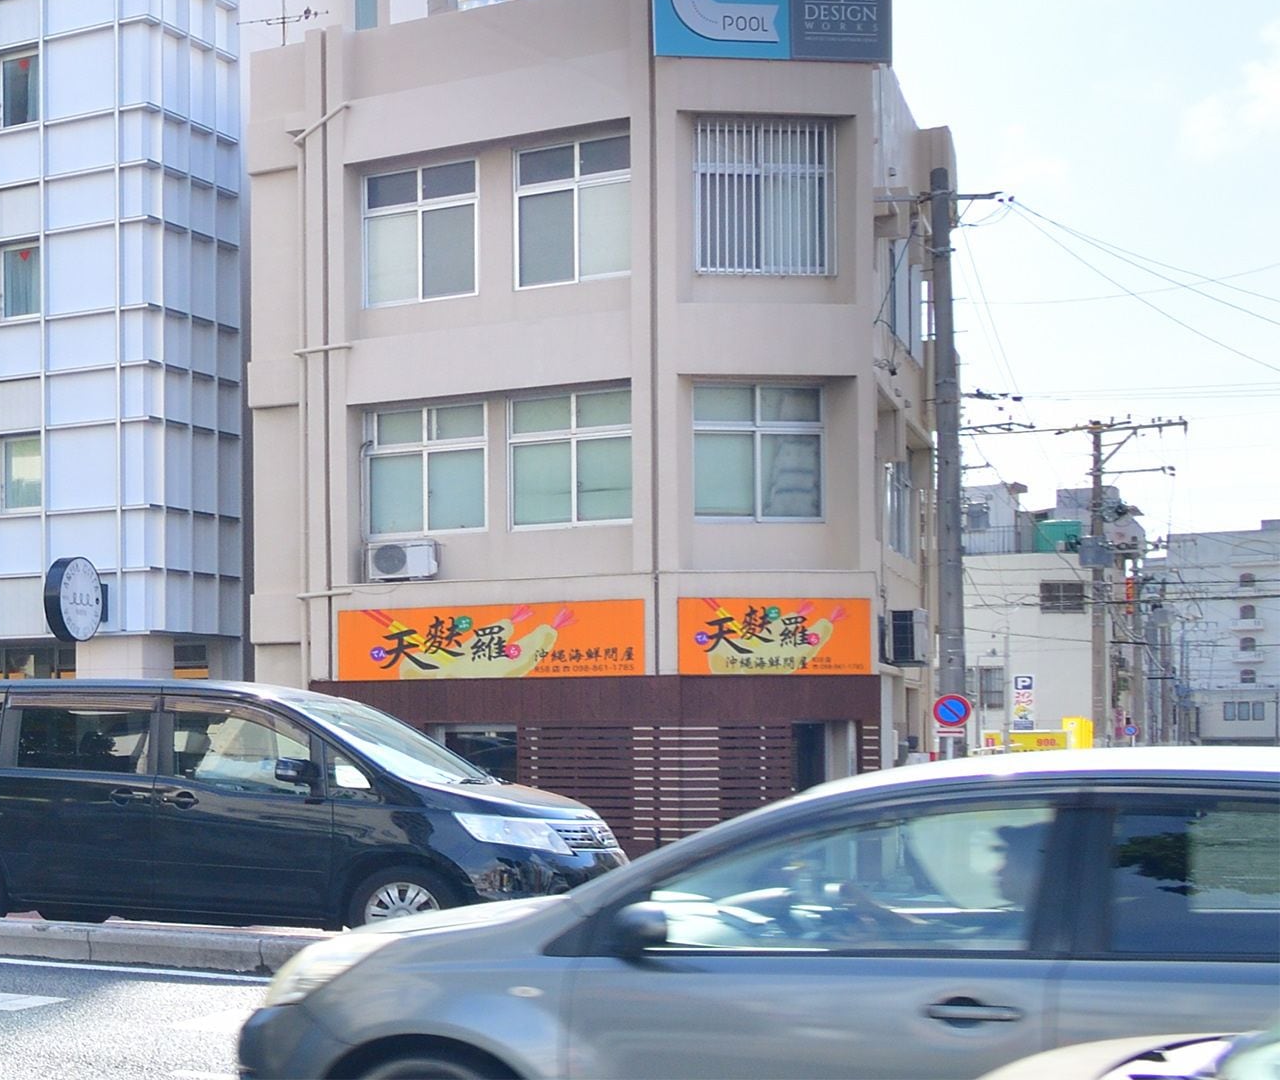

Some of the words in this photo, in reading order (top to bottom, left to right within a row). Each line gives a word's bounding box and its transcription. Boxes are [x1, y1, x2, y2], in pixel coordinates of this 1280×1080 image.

[803, 4, 878, 21] DESIGN
[722, 15, 769, 32] POOL
[804, 22, 879, 32] WORKS
[1017, 678, 1031, 690] P
